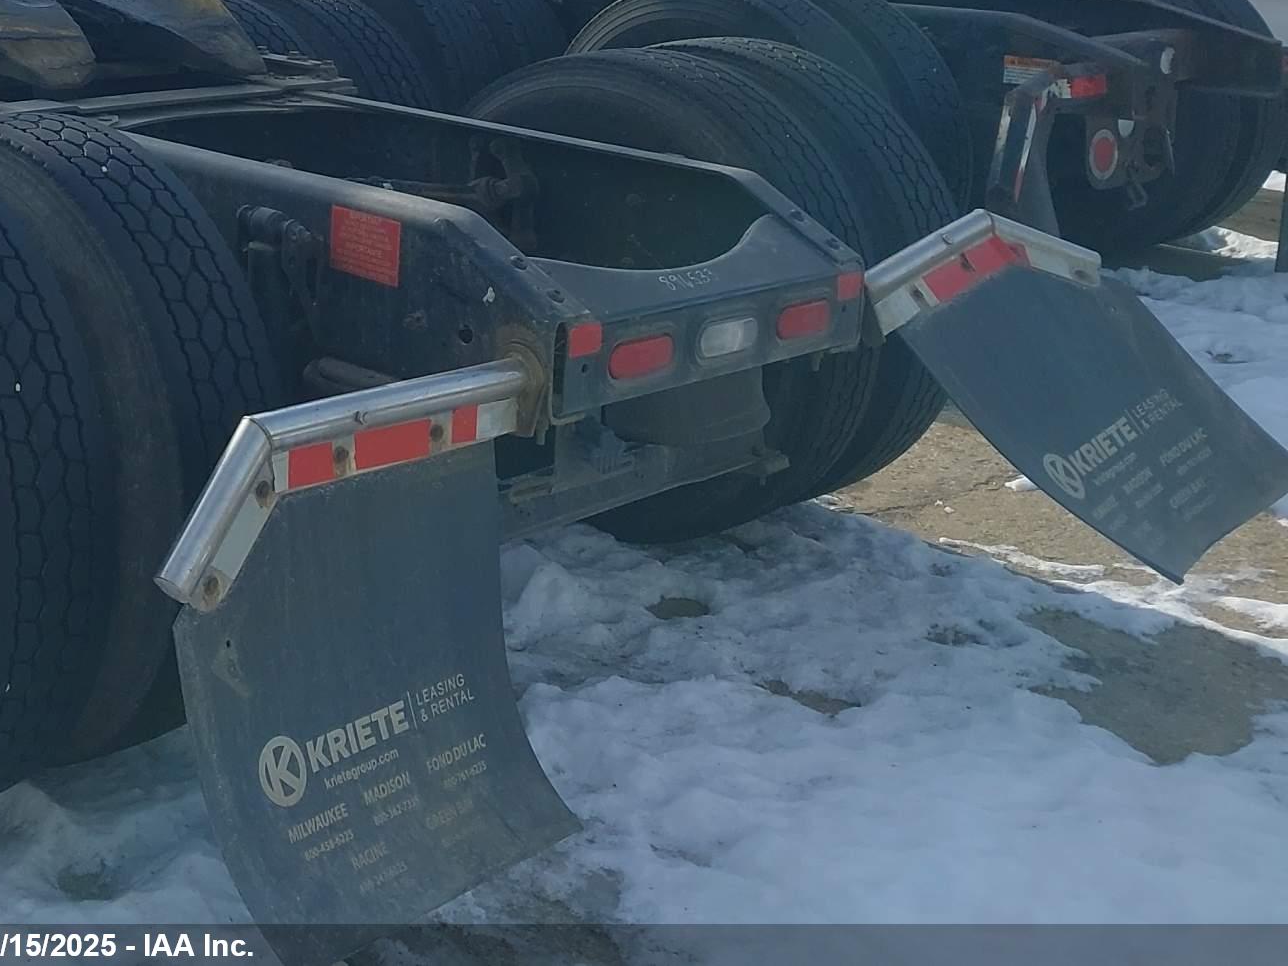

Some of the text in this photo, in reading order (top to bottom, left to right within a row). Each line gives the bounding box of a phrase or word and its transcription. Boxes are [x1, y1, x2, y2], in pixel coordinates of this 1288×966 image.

[1068, 416, 1138, 477] KRIETE
[306, 700, 410, 775] KRIETE
[415, 673, 466, 707] LEASING
[431, 688, 476, 719] RENTAL
[468, 732, 488, 754] LAC
[323, 747, 400, 791] krietegroup.com
[363, 770, 412, 806] MADISON
[287, 801, 350, 845] MILWAUKEE
